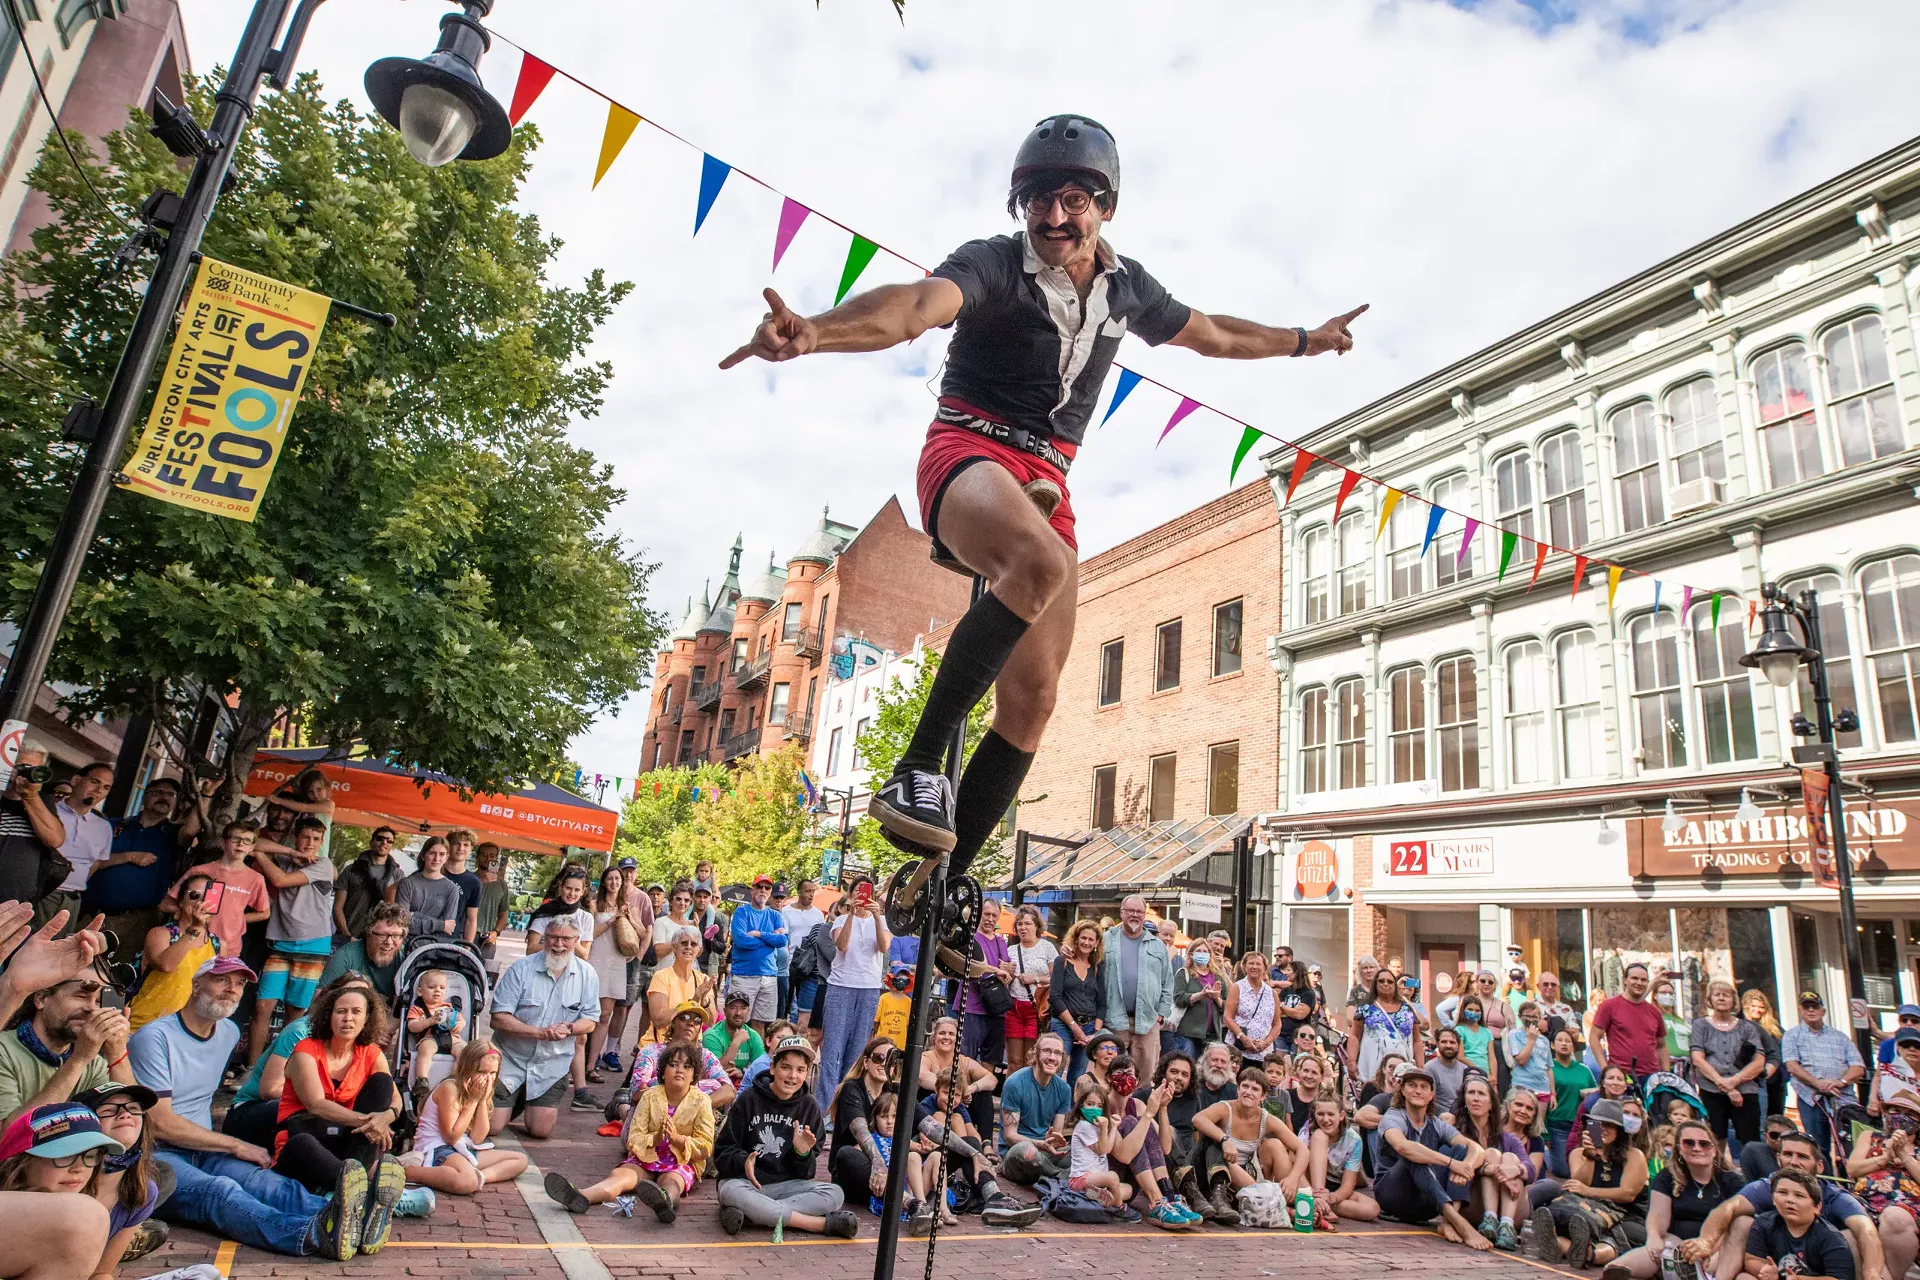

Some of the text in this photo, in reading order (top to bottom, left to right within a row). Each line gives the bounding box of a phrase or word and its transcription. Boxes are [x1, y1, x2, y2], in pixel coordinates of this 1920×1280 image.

[208, 262, 298, 302] Community
[201, 288, 233, 303] PRESENTS
[233, 283, 271, 306] Bank
[213, 313, 242, 334] OF
[137, 302, 211, 474] BURLINGTON CITY ARTS
[155, 344, 235, 487] FESTIVAL
[191, 322, 309, 502] FOOLS
[170, 490, 251, 513] VTFOOLS.ORG
[517, 811, 604, 835] @BTVCITYARTS
[1394, 845, 1423, 872] 22
[1691, 852, 1770, 868] TRADING
